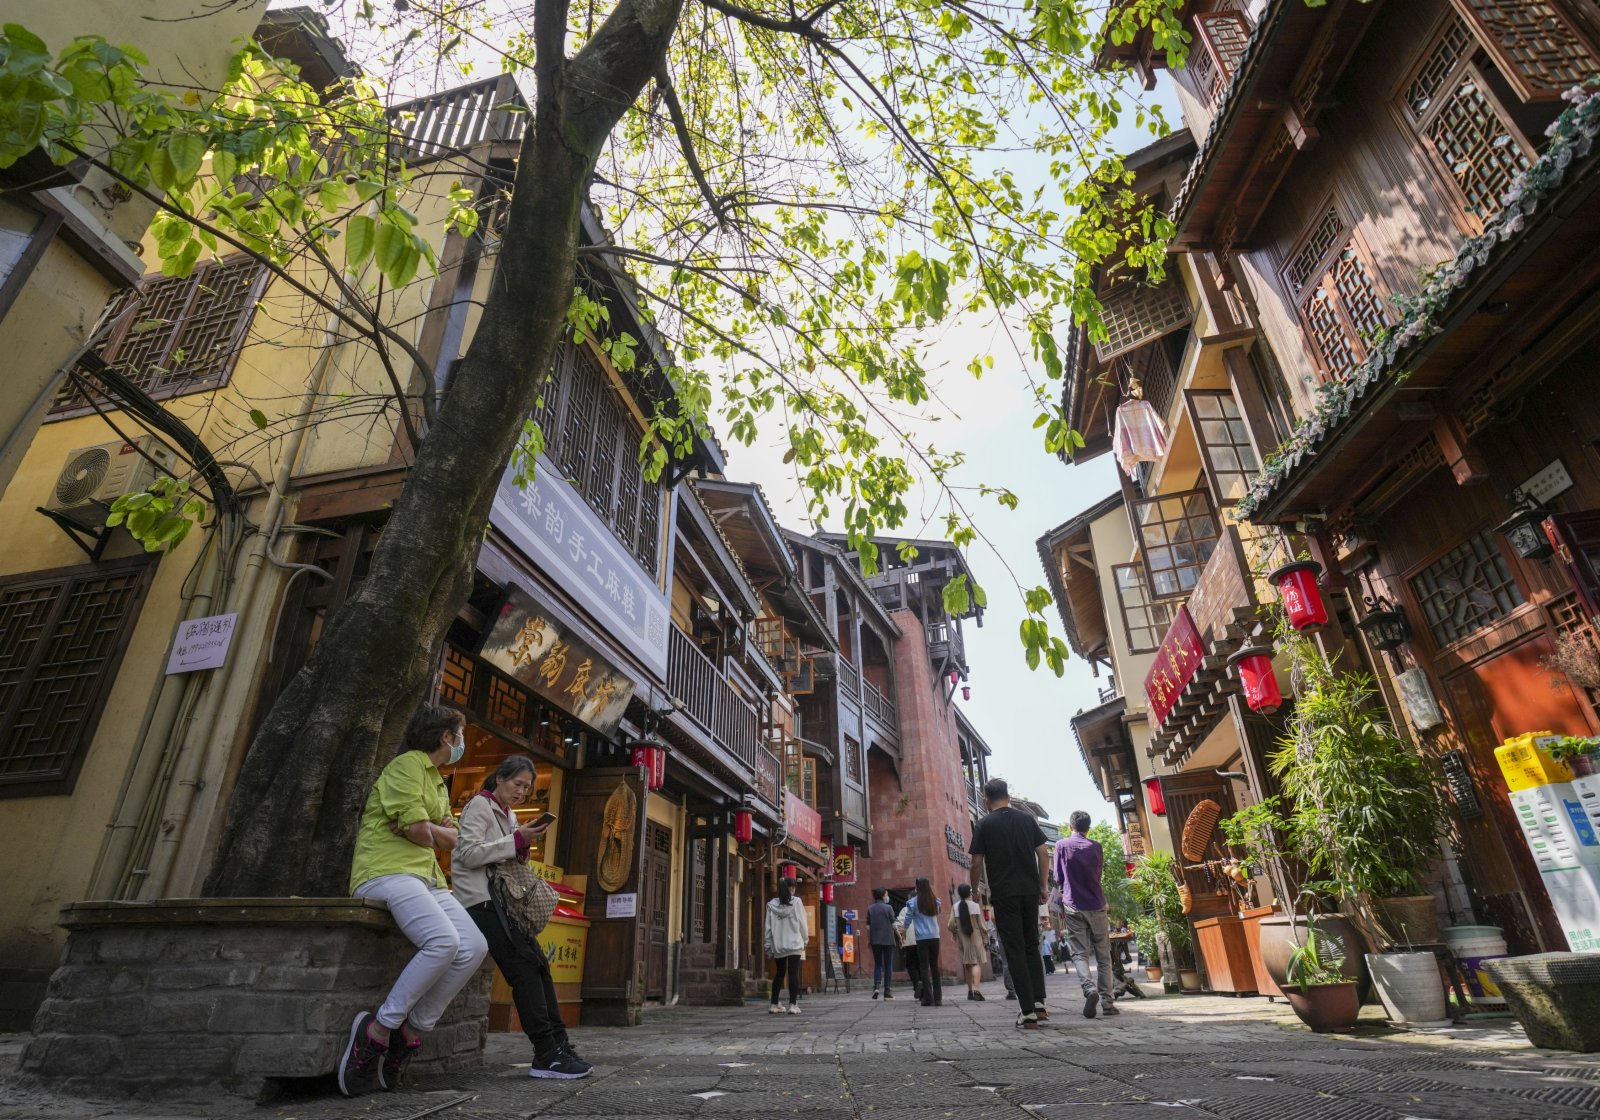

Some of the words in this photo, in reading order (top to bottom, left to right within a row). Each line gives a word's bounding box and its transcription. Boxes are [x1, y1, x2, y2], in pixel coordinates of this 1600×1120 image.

[518, 483, 637, 621] 棠韵手工麻鞋
